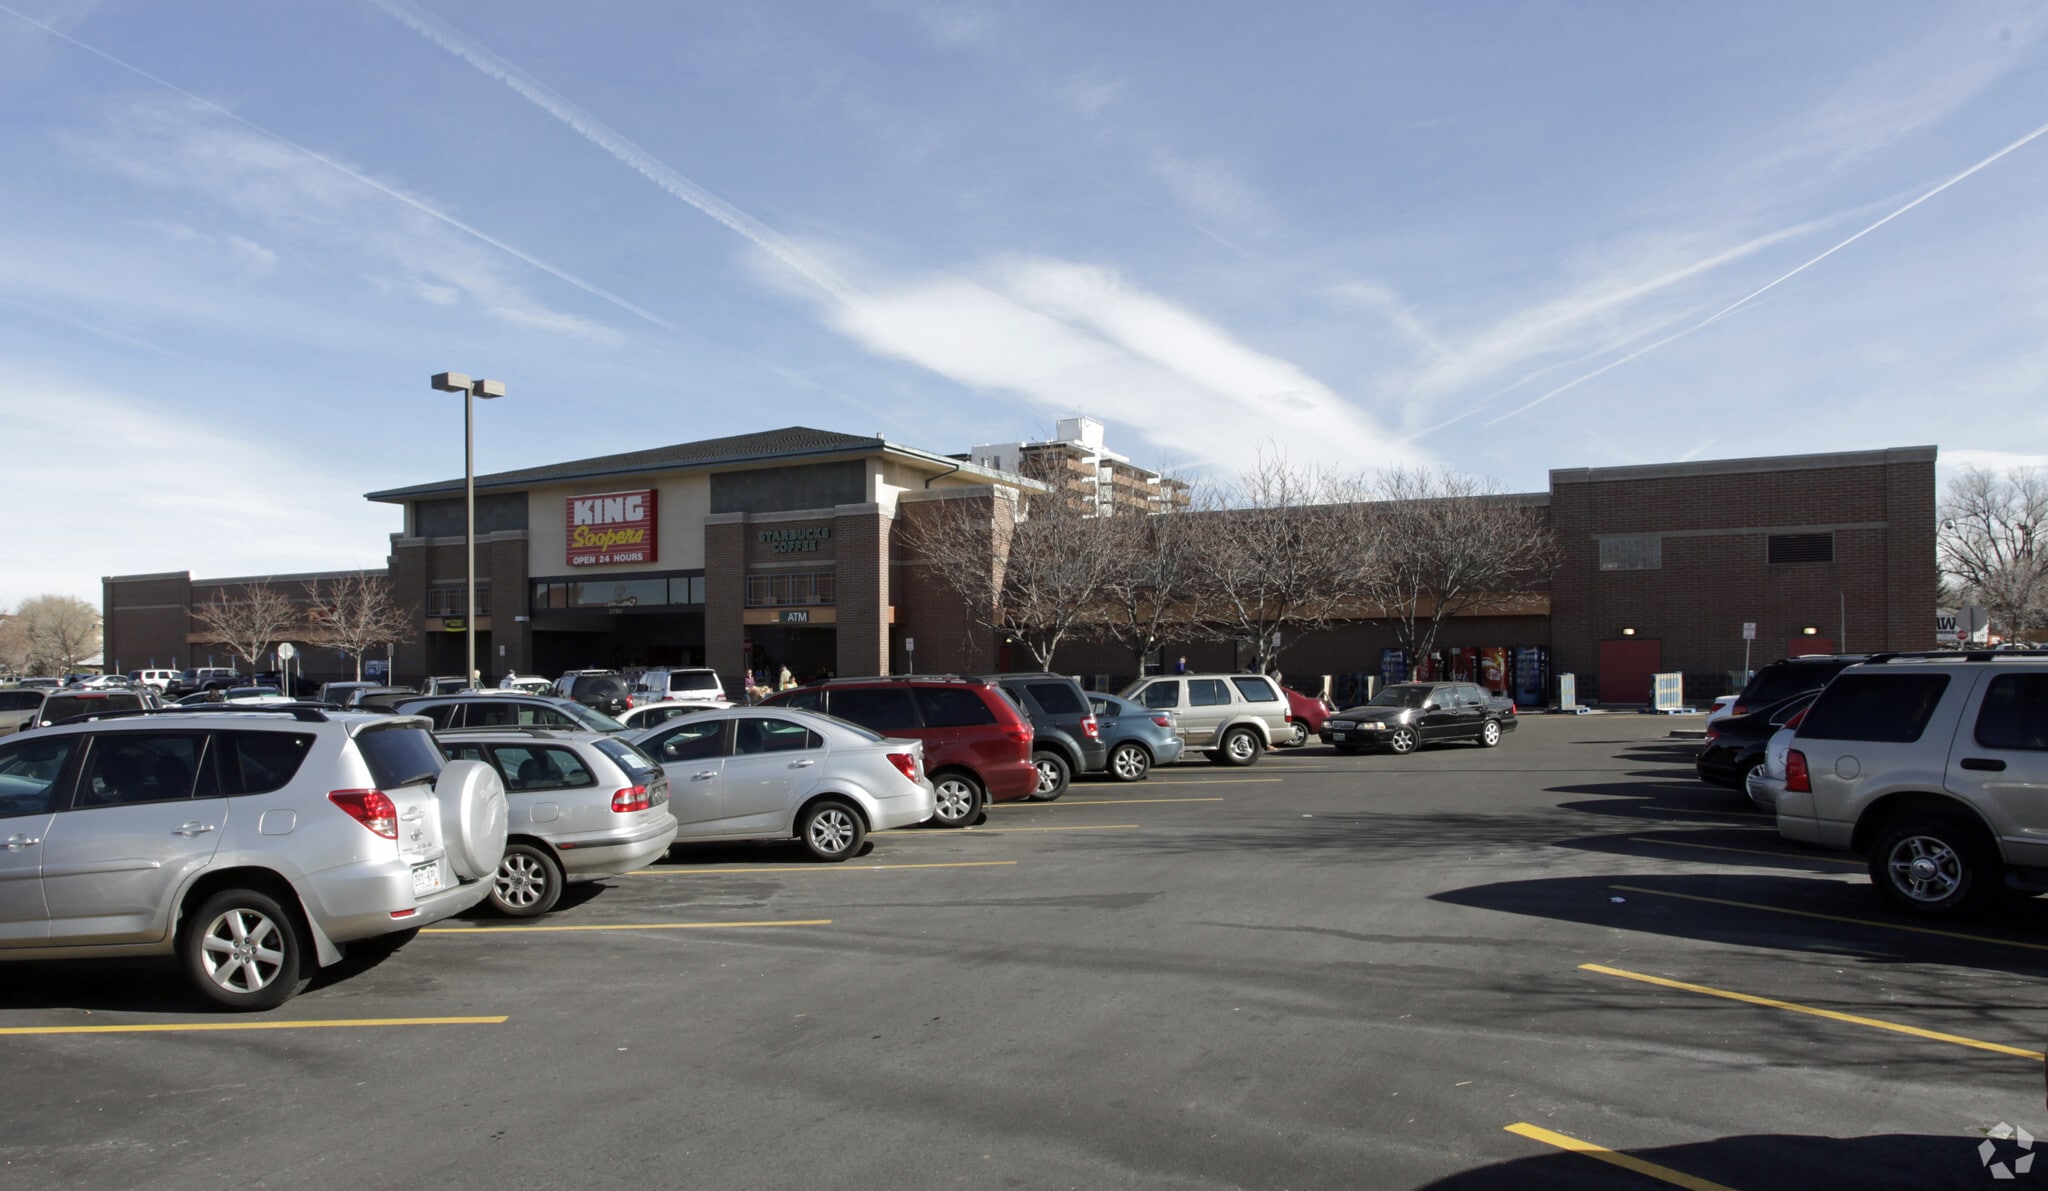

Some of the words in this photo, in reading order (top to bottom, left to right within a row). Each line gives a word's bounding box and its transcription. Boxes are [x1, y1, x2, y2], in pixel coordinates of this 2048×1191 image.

[573, 495, 644, 526] KING
[571, 525, 645, 552] Soopers
[758, 527, 831, 543] STARBUCKS
[770, 540, 818, 553] COFFEE
[573, 555, 596, 565] OPEN
[599, 554, 611, 564] 24
[613, 552, 643, 563] HOURS
[787, 611, 808, 622] ATM
